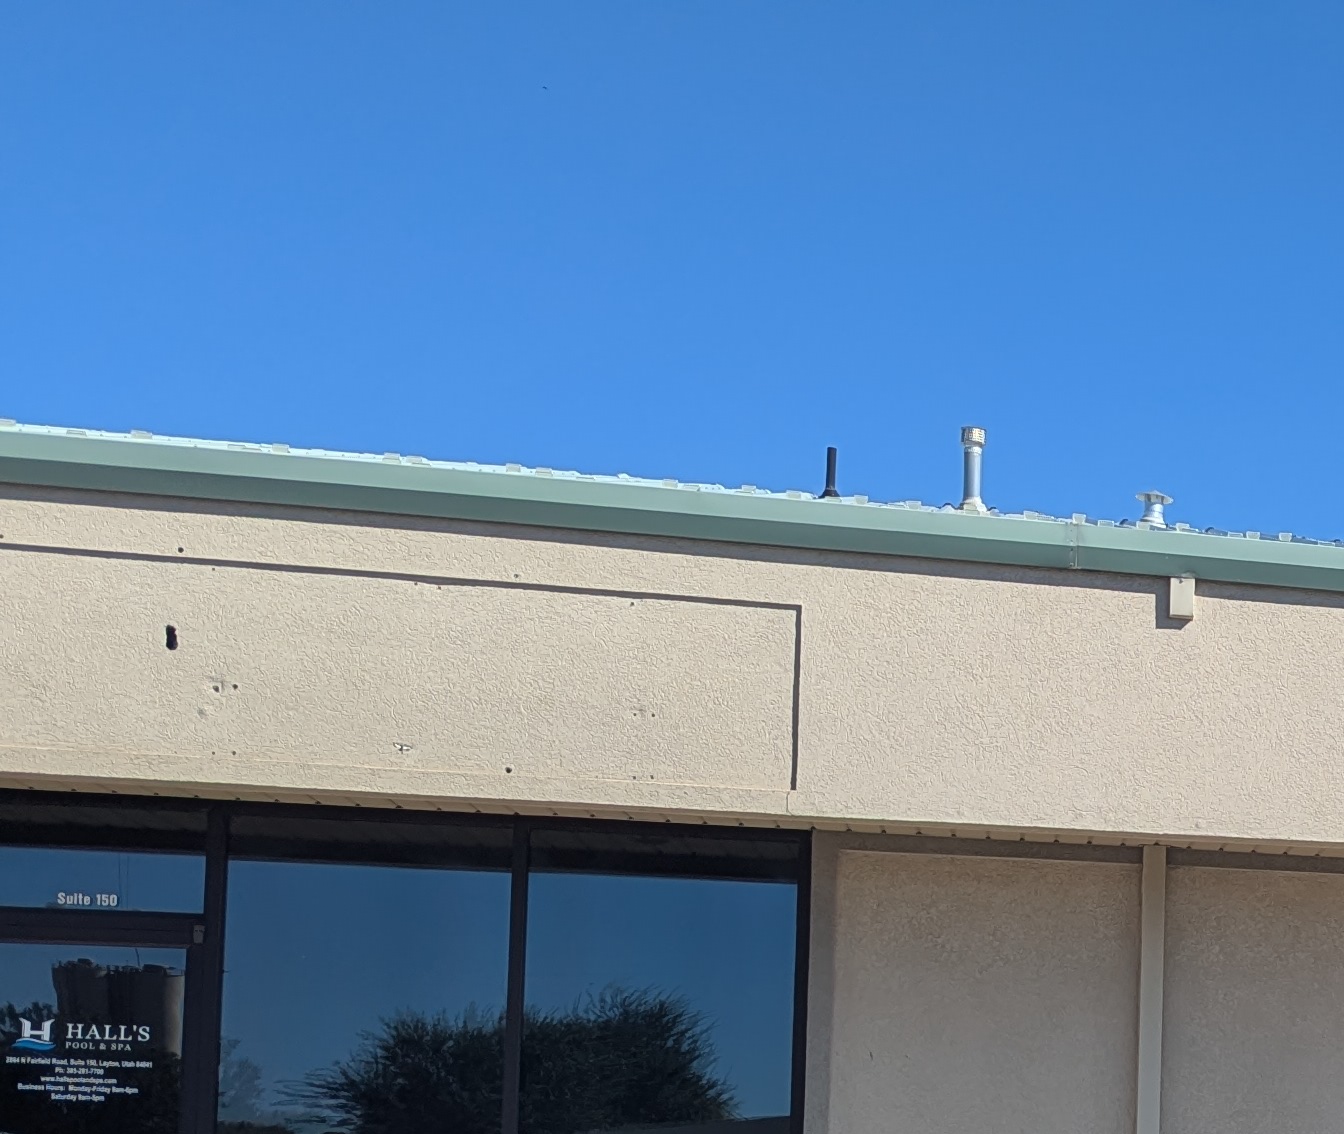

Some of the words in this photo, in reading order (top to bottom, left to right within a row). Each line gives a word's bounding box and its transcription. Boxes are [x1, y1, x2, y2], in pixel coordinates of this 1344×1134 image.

[57, 892, 90, 905] Suite
[96, 894, 118, 906] 150
[65, 1023, 150, 1041] HALL'S
[65, 1041, 95, 1050] POOL
[99, 1043, 107, 1051] &
[110, 1043, 132, 1051] SPA
